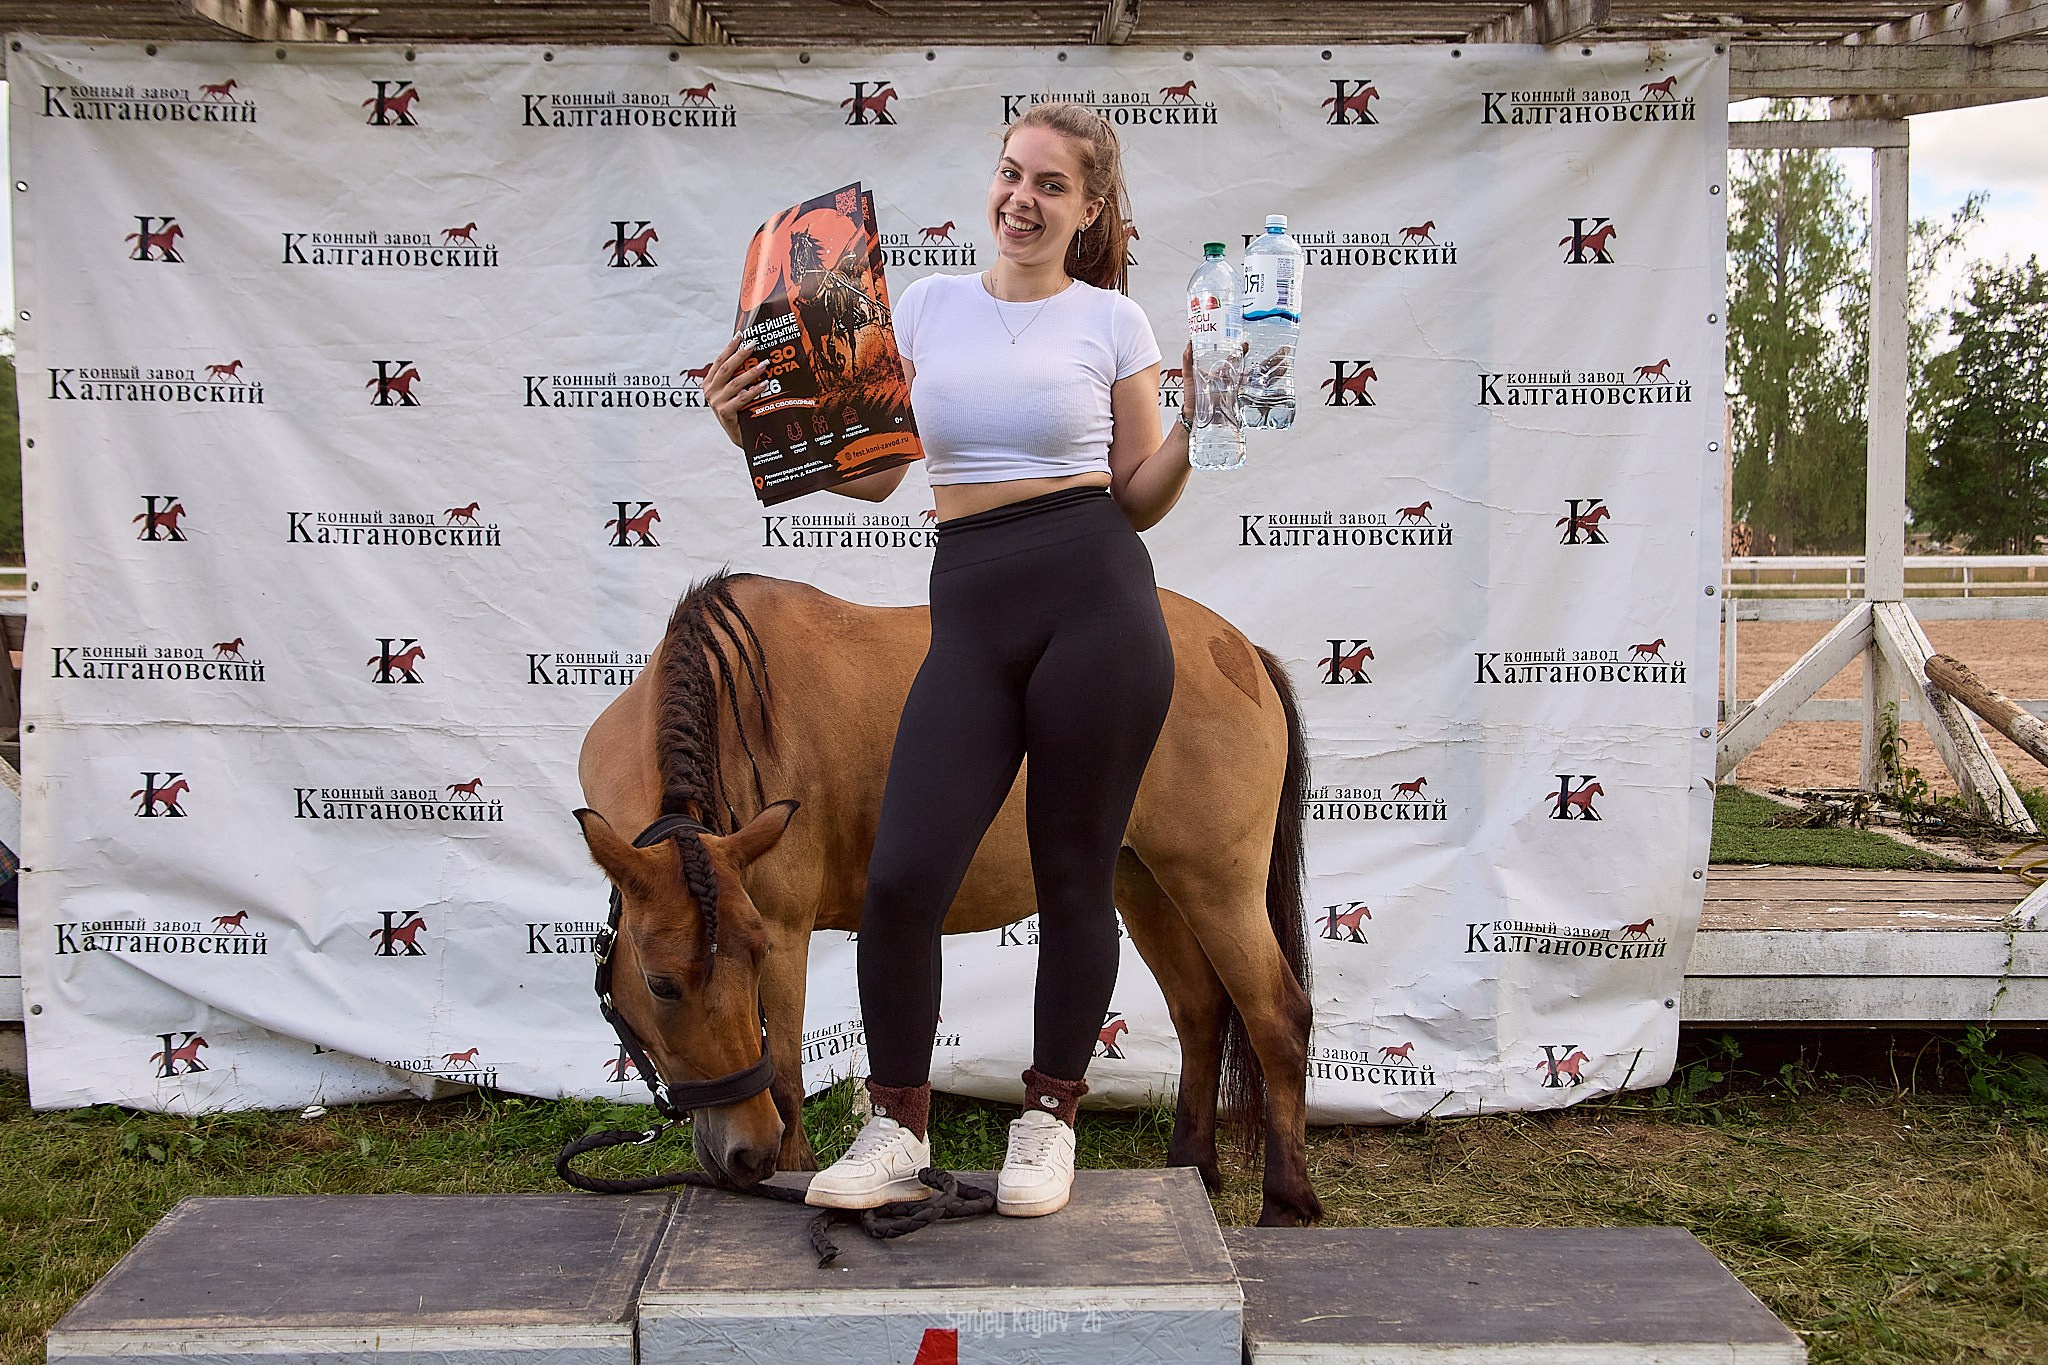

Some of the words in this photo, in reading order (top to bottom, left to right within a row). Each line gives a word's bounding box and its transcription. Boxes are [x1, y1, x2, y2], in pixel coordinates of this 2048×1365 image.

[40, 84, 257, 123] Калгановский
[70, 84, 135, 99] конный
[140, 87, 190, 103] завод
[551, 89, 617, 107] конный
[622, 92, 670, 108] завод
[1102, 92, 1151, 105] завод
[1510, 88, 1576, 103] конный
[1582, 88, 1631, 103] завод
[521, 94, 738, 128] Калгановский
[1000, 95, 1219, 125] Кновский
[1480, 92, 1697, 124] Калгановский
[311, 230, 378, 246] конный
[383, 233, 432, 248] завод
[881, 233, 910, 246] вод
[1291, 230, 1336, 244] нный
[1342, 232, 1390, 245] завод
[282, 232, 500, 268] Калгановский
[1242, 234, 1458, 266] гановский
[742, 312, 797, 339] ПНЕЙШЕЕ
[760, 323, 800, 343] СОБЫТИЕ
[769, 345, 796, 364] 30
[78, 364, 141, 381] конный
[146, 369, 195, 384] завод
[552, 373, 617, 386] конный
[623, 375, 671, 388] завод
[1507, 369, 1573, 385] конный
[1577, 370, 1626, 386] завод
[47, 368, 265, 405] Калгановский
[523, 376, 711, 408] Калгановск
[1478, 374, 1693, 406] Калгановский
[755, 404, 776, 415] ВХОД
[775, 399, 816, 409] СВОБОДНЫЙ
[852, 436, 909, 459] fest.koni-zavod.ru
[317, 510, 384, 525] конный
[388, 512, 435, 527] завод
[791, 512, 856, 527] конный
[862, 515, 910, 528] завод
[1268, 510, 1333, 524] конный
[1339, 513, 1387, 526] завод
[286, 512, 501, 548] Калгановский
[762, 516, 939, 548] Калгановск
[1239, 514, 1454, 547] Калгановский
[82, 643, 147, 659] конный
[154, 646, 204, 661] завод
[555, 650, 619, 664] конный
[1503, 648, 1567, 663] конный
[1572, 649, 1619, 663] завод
[51, 646, 266, 682] Калгановский
[526, 653, 642, 686] Калган
[1474, 652, 1687, 685] Калгановский
[321, 786, 385, 801] конный
[391, 788, 438, 803] завод
[1335, 787, 1382, 801] завод
[294, 788, 504, 823] Калгановский
[1299, 797, 1449, 821] гановский
[81, 917, 147, 934] конный
[153, 919, 201, 935] завод
[554, 921, 603, 933] конн
[1493, 919, 1558, 935] конный
[1563, 924, 1611, 940] завод
[54, 922, 268, 956] Калгановский
[1464, 923, 1667, 960] Калгановский
[1322, 1047, 1369, 1064] завод
[1306, 1062, 1437, 1086] ановский
